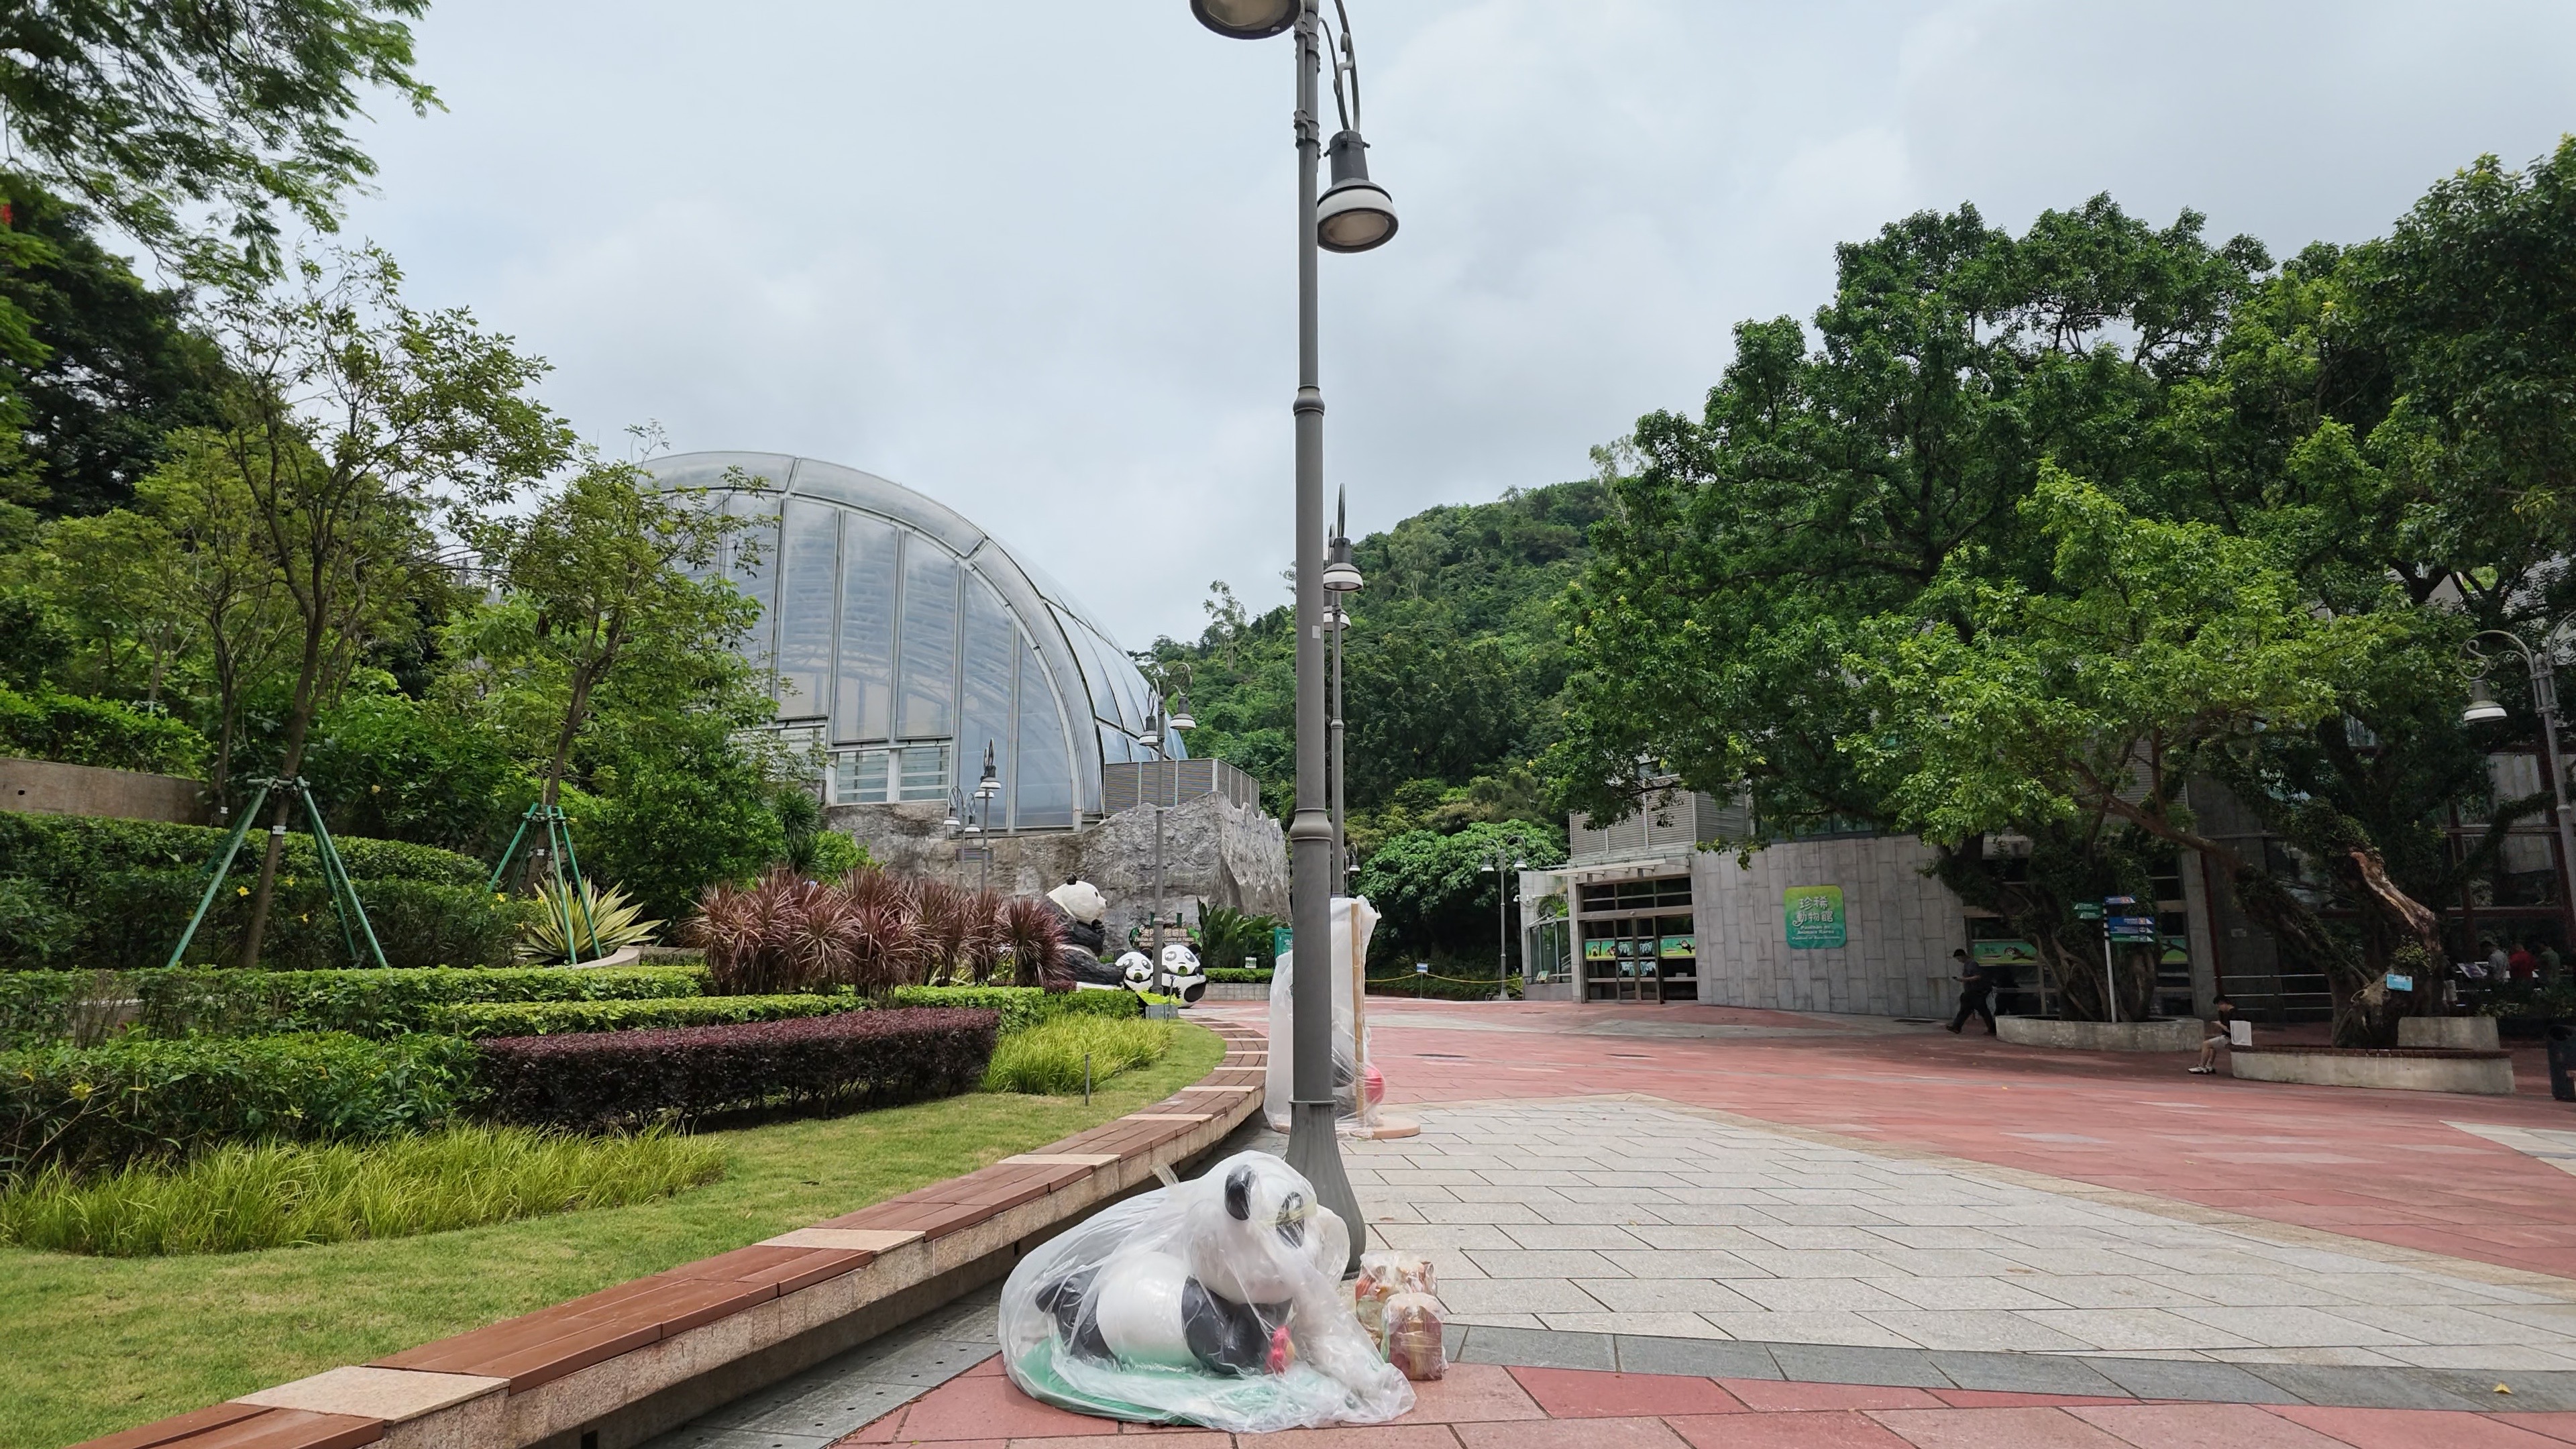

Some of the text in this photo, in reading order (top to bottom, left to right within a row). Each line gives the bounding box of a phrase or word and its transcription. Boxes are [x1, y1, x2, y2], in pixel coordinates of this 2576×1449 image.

[1799, 896, 1829, 911] 珍稀
[1792, 909, 1834, 927] 動物館
